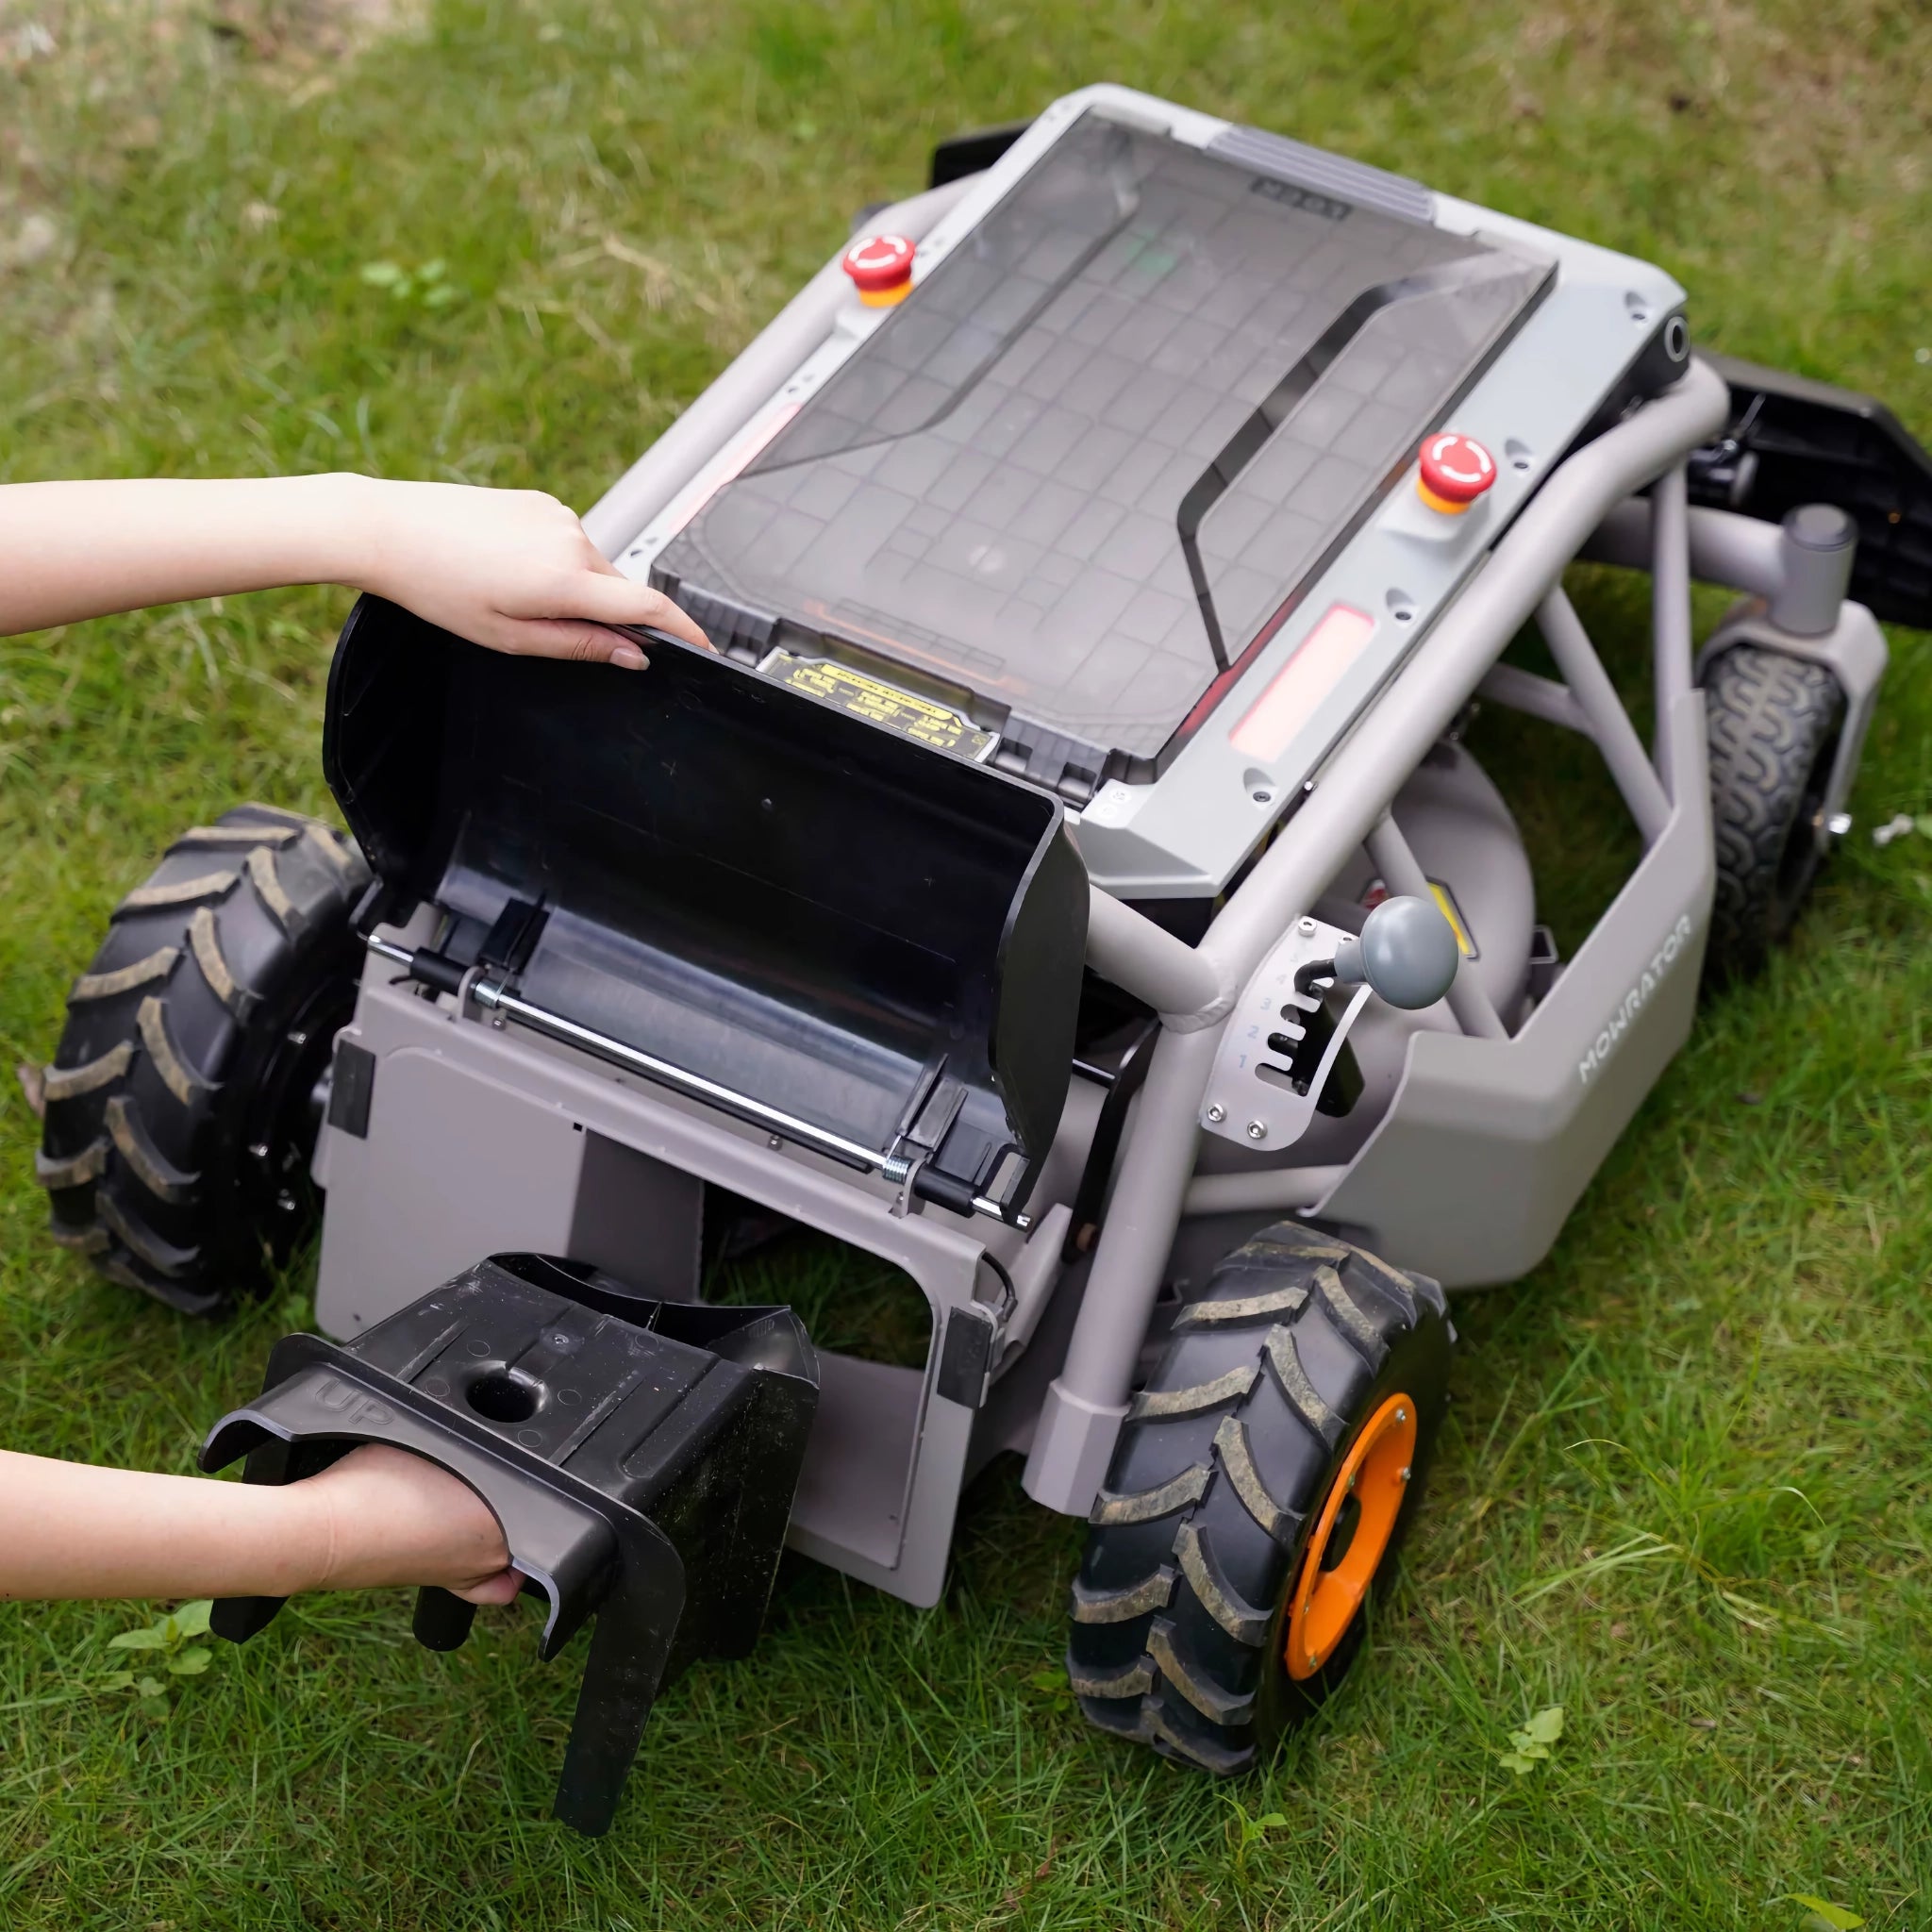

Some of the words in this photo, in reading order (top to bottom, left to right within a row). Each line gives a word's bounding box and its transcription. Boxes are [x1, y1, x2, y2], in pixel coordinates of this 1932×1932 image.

[1259, 997, 1273, 1010] 3
[1578, 913, 1692, 1084] MOWRATOR
[1246, 1024, 1260, 1040] 2
[1238, 1054, 1248, 1070] 1
[315, 1376, 396, 1425] UP
